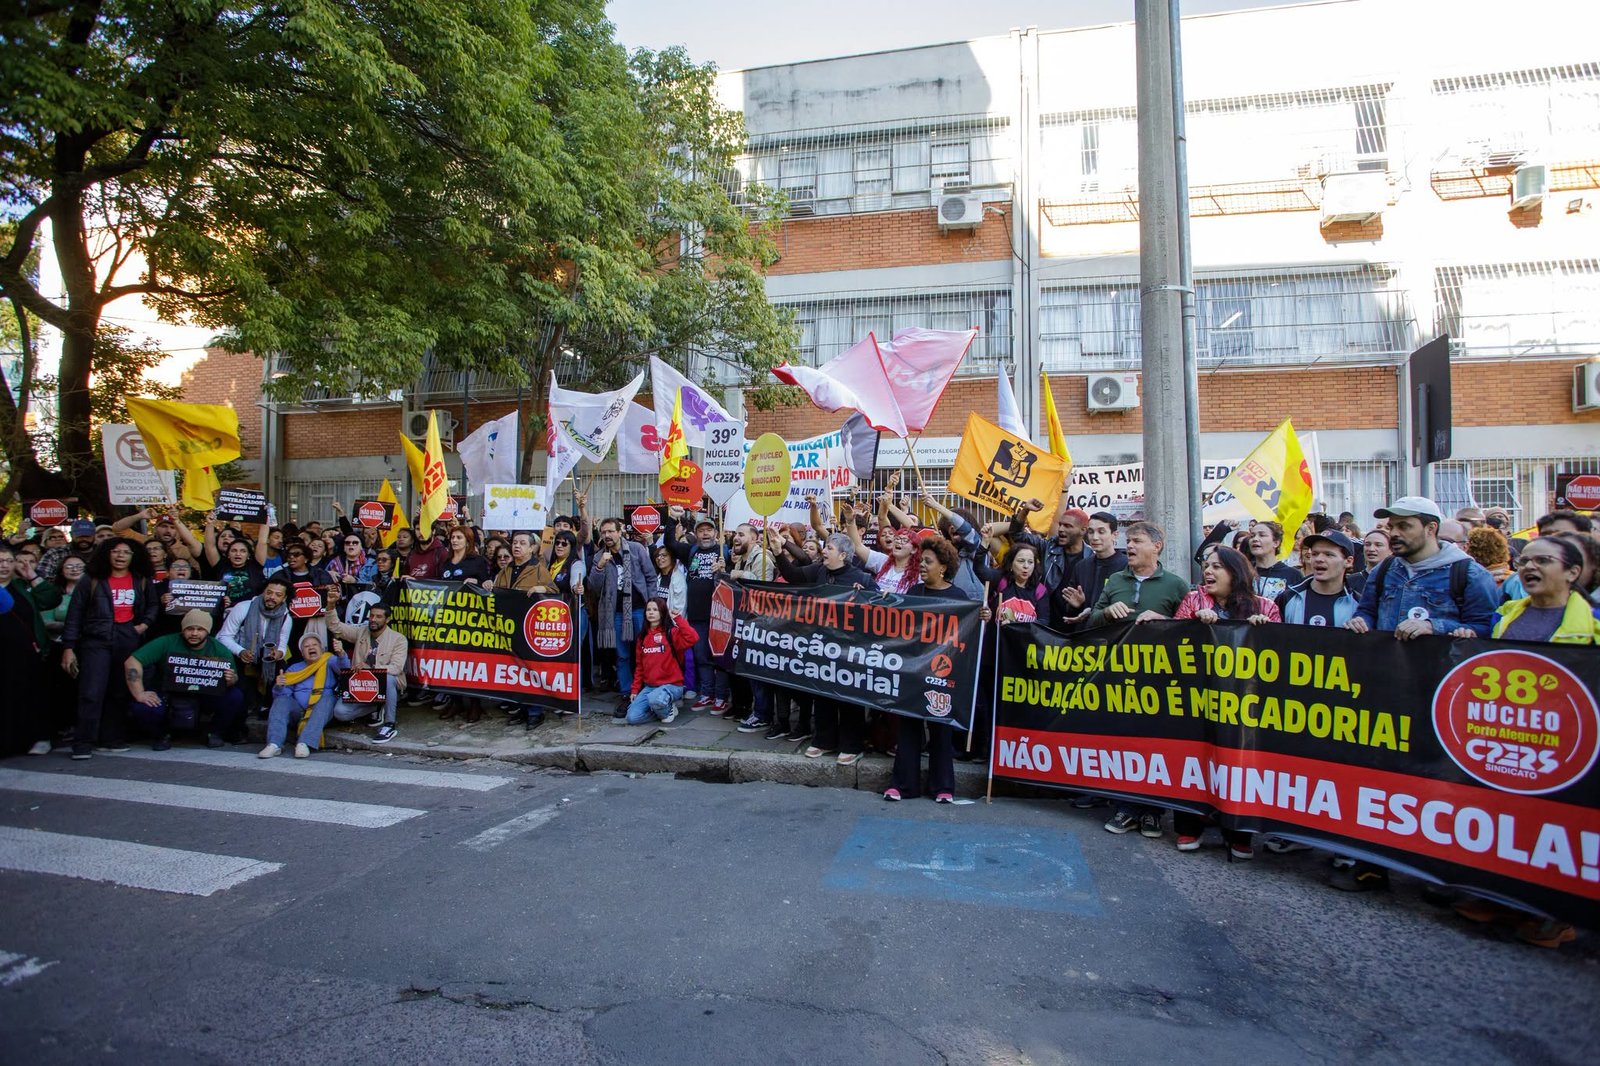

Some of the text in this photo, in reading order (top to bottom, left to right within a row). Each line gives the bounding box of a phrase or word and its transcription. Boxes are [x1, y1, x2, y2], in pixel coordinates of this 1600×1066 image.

[711, 428, 737, 444] 39º
[705, 449, 740, 458] NÚCLEO
[791, 452, 819, 470] AR
[1105, 468, 1144, 484] TAM
[790, 487, 800, 496] NA
[406, 589, 444, 606] NOSSA
[447, 591, 485, 613] LUTA
[487, 594, 495, 613] É
[408, 607, 432, 625] DIA,
[434, 608, 516, 635] EDUCAÇÃO
[535, 620, 567, 631] NÚCLEO
[738, 588, 967, 653] A NOSSA LUTA É TODO DIA,
[411, 624, 513, 652] MERCADORIA!
[735, 619, 903, 671] Educação não
[168, 656, 231, 669] CHEGA DE PLANILHAS
[180, 667, 223, 678] PRECARIZAÇÃO
[732, 640, 901, 697] é mercadoria!
[1026, 638, 1362, 699] A NOSSA LUTA É TODO DIA,
[185, 677, 218, 687] EDUCAÇÃO!
[420, 658, 488, 683] MINHA
[494, 663, 573, 694] ESCOLA!
[1470, 666, 1559, 705] 38º
[1001, 676, 1412, 753] EDUCAÇÃO NÃO É MERCADORIA!
[1467, 701, 1560, 732] NÚCLEO
[1467, 723, 1560, 748] Porto Alegre/ZN
[1466, 738, 1559, 774] CPERS
[1485, 763, 1538, 780] SINDICATO
[999, 736, 1600, 882] NÃO VENDA A MINHA ESCOLA!
